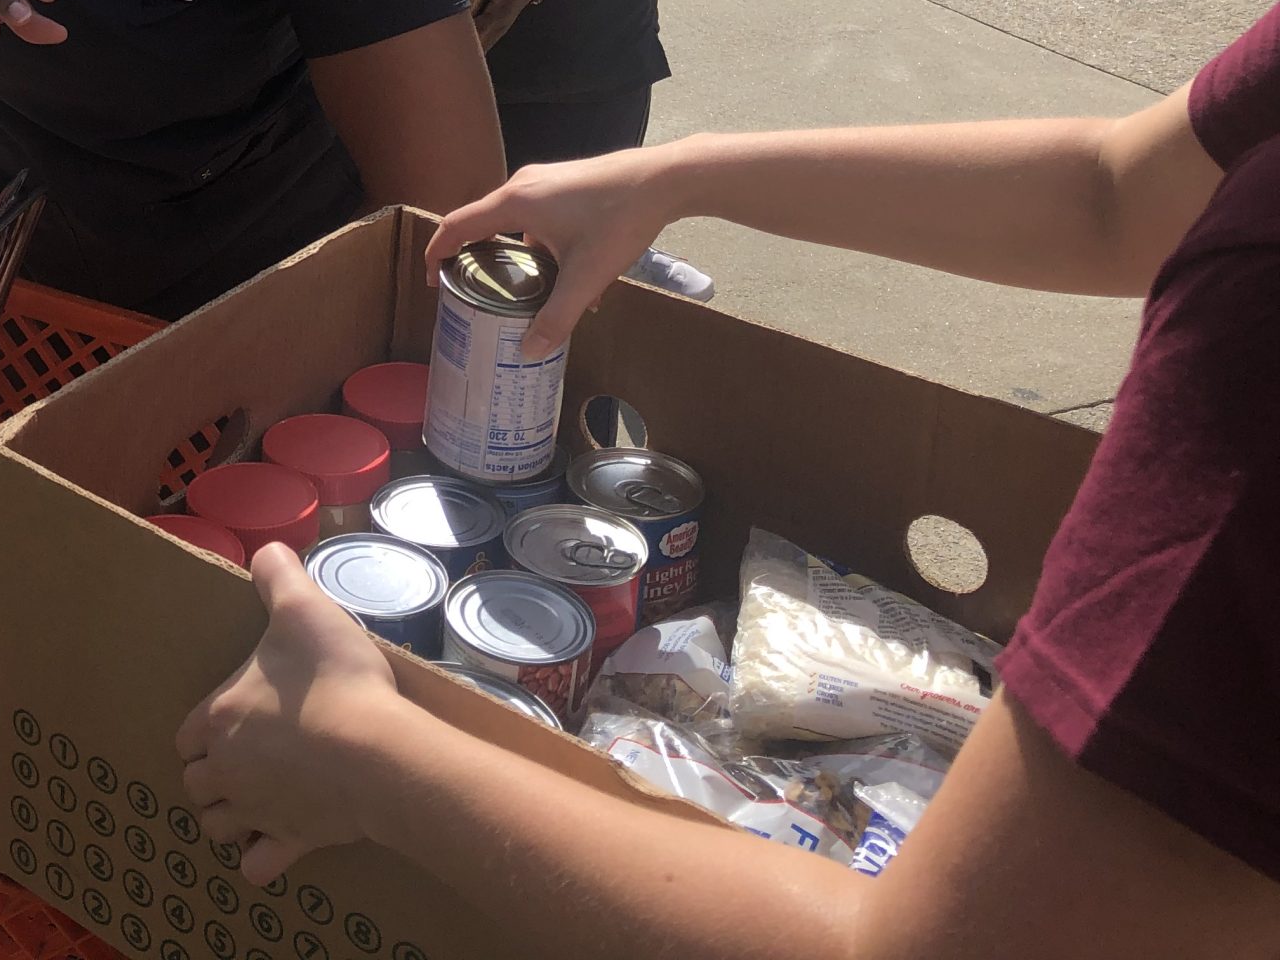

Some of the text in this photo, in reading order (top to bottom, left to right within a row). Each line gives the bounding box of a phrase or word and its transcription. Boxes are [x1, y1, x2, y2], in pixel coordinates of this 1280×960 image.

[489, 431, 526, 442] 70 230
[485, 463, 515, 474] Facts
[646, 566, 684, 584] Light
[818, 673, 859, 688] GLUTEN FREE
[900, 682, 920, 695] Our
[920, 689, 962, 709] growers
